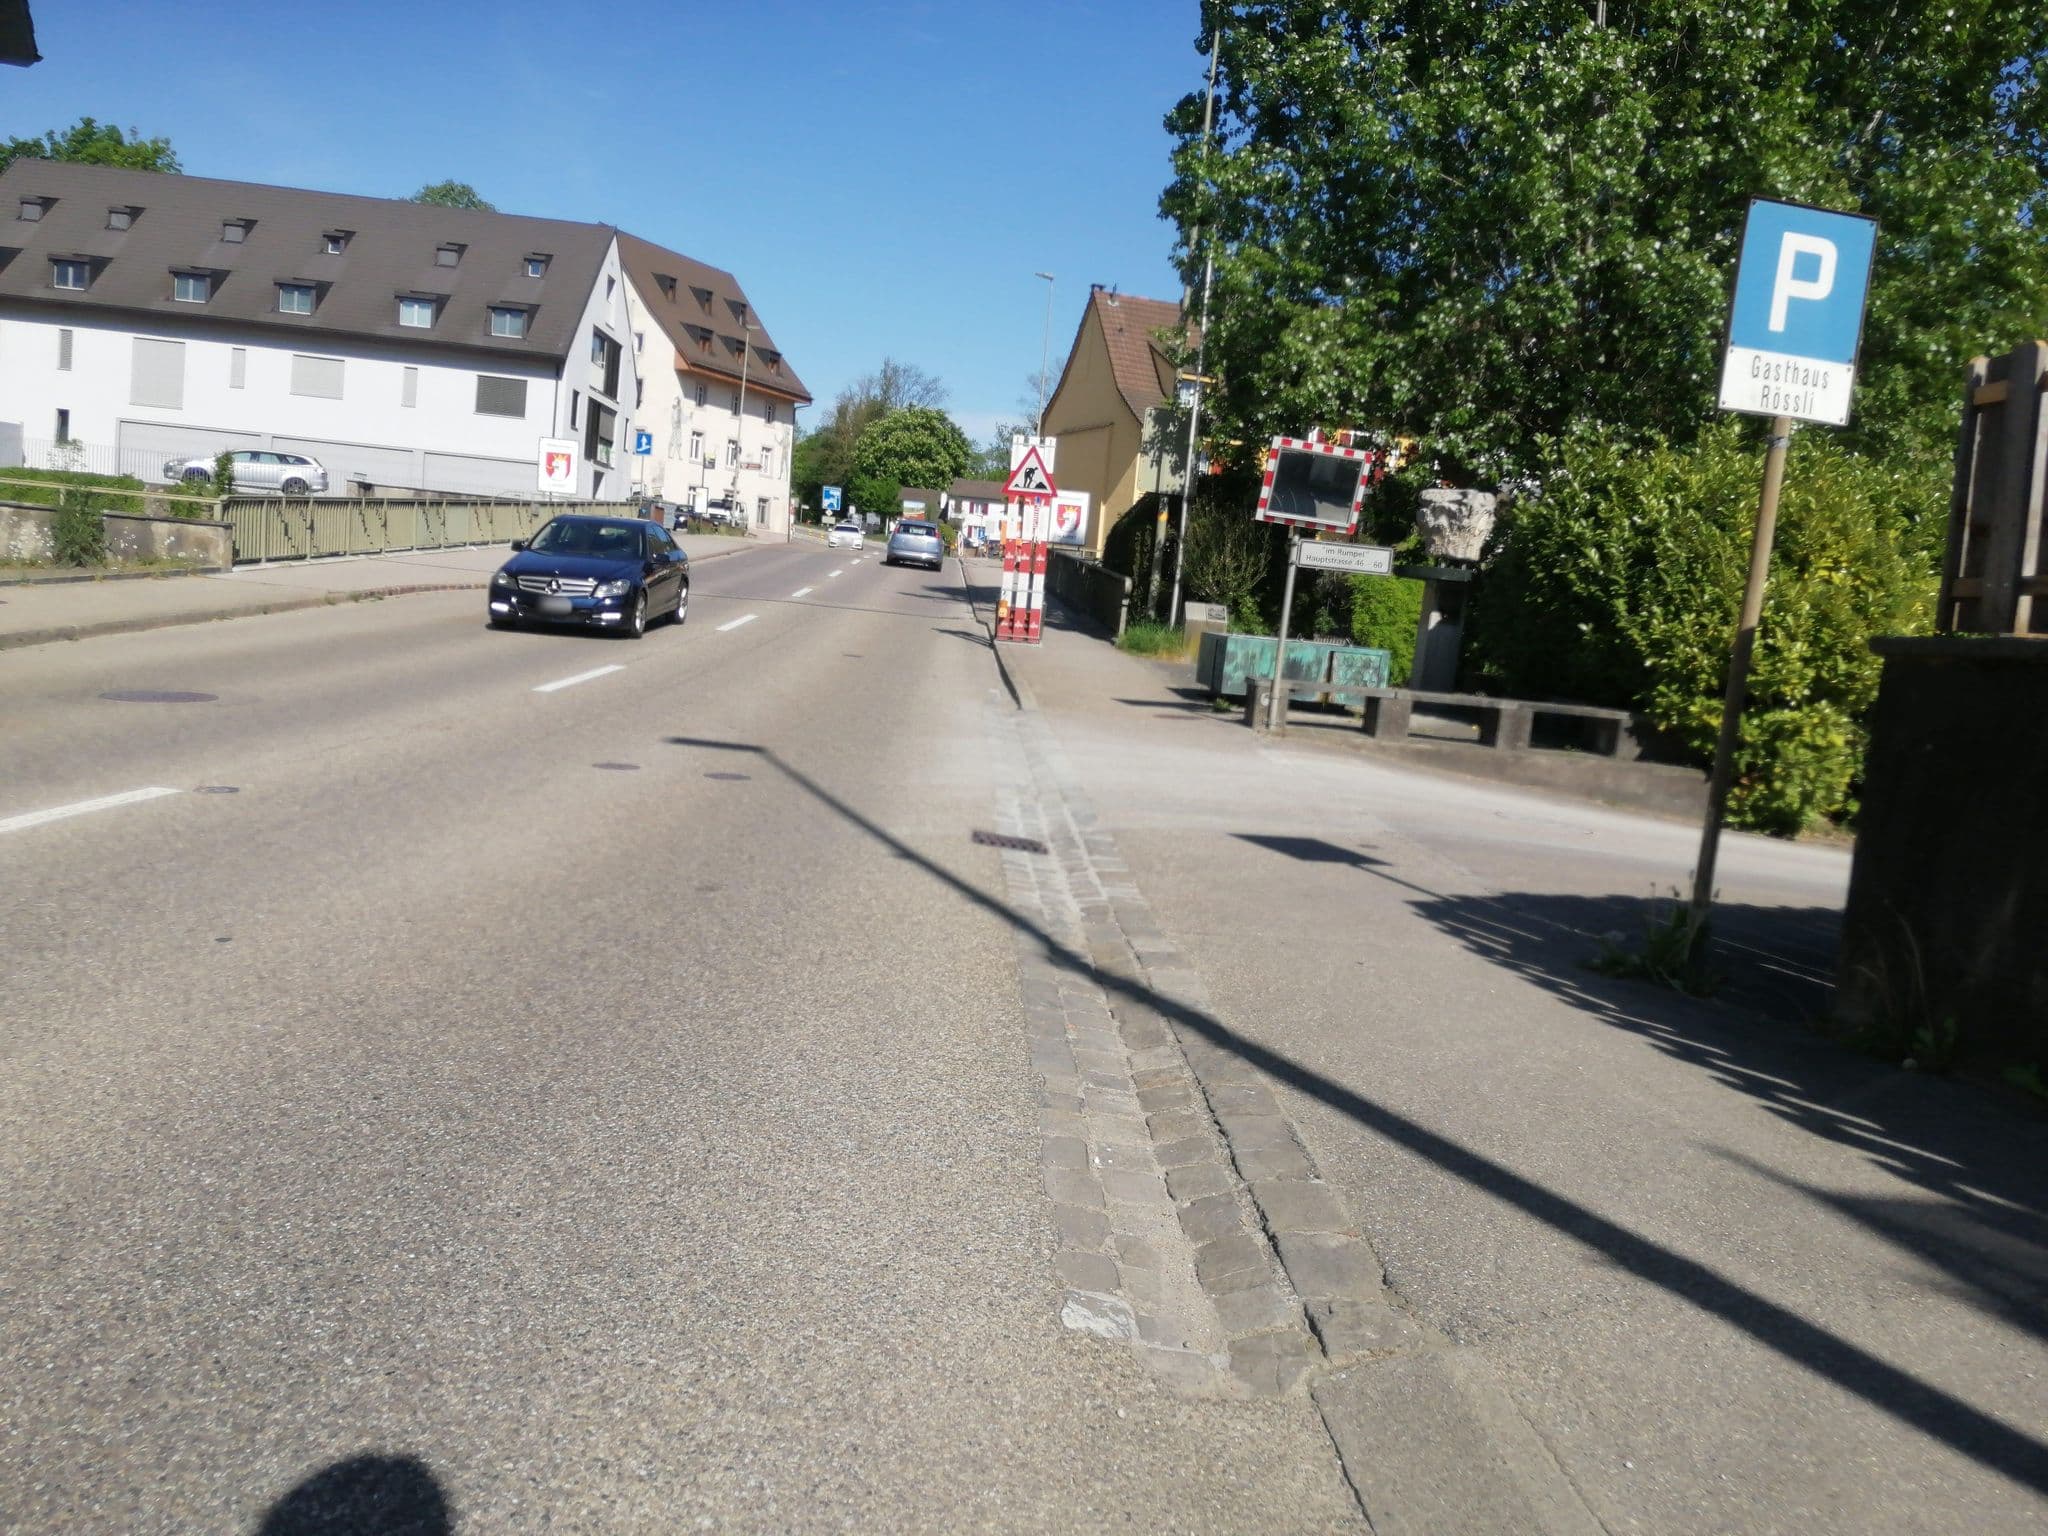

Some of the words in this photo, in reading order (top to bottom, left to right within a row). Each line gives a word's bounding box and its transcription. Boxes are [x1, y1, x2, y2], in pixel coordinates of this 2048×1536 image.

[1768, 231, 1838, 333] P
[1751, 355, 1829, 389] Gasthaus
[1760, 385, 1815, 415] Rössli
[1305, 554, 1353, 566] Hauptstrasse
[1373, 561, 1383, 569] 60
